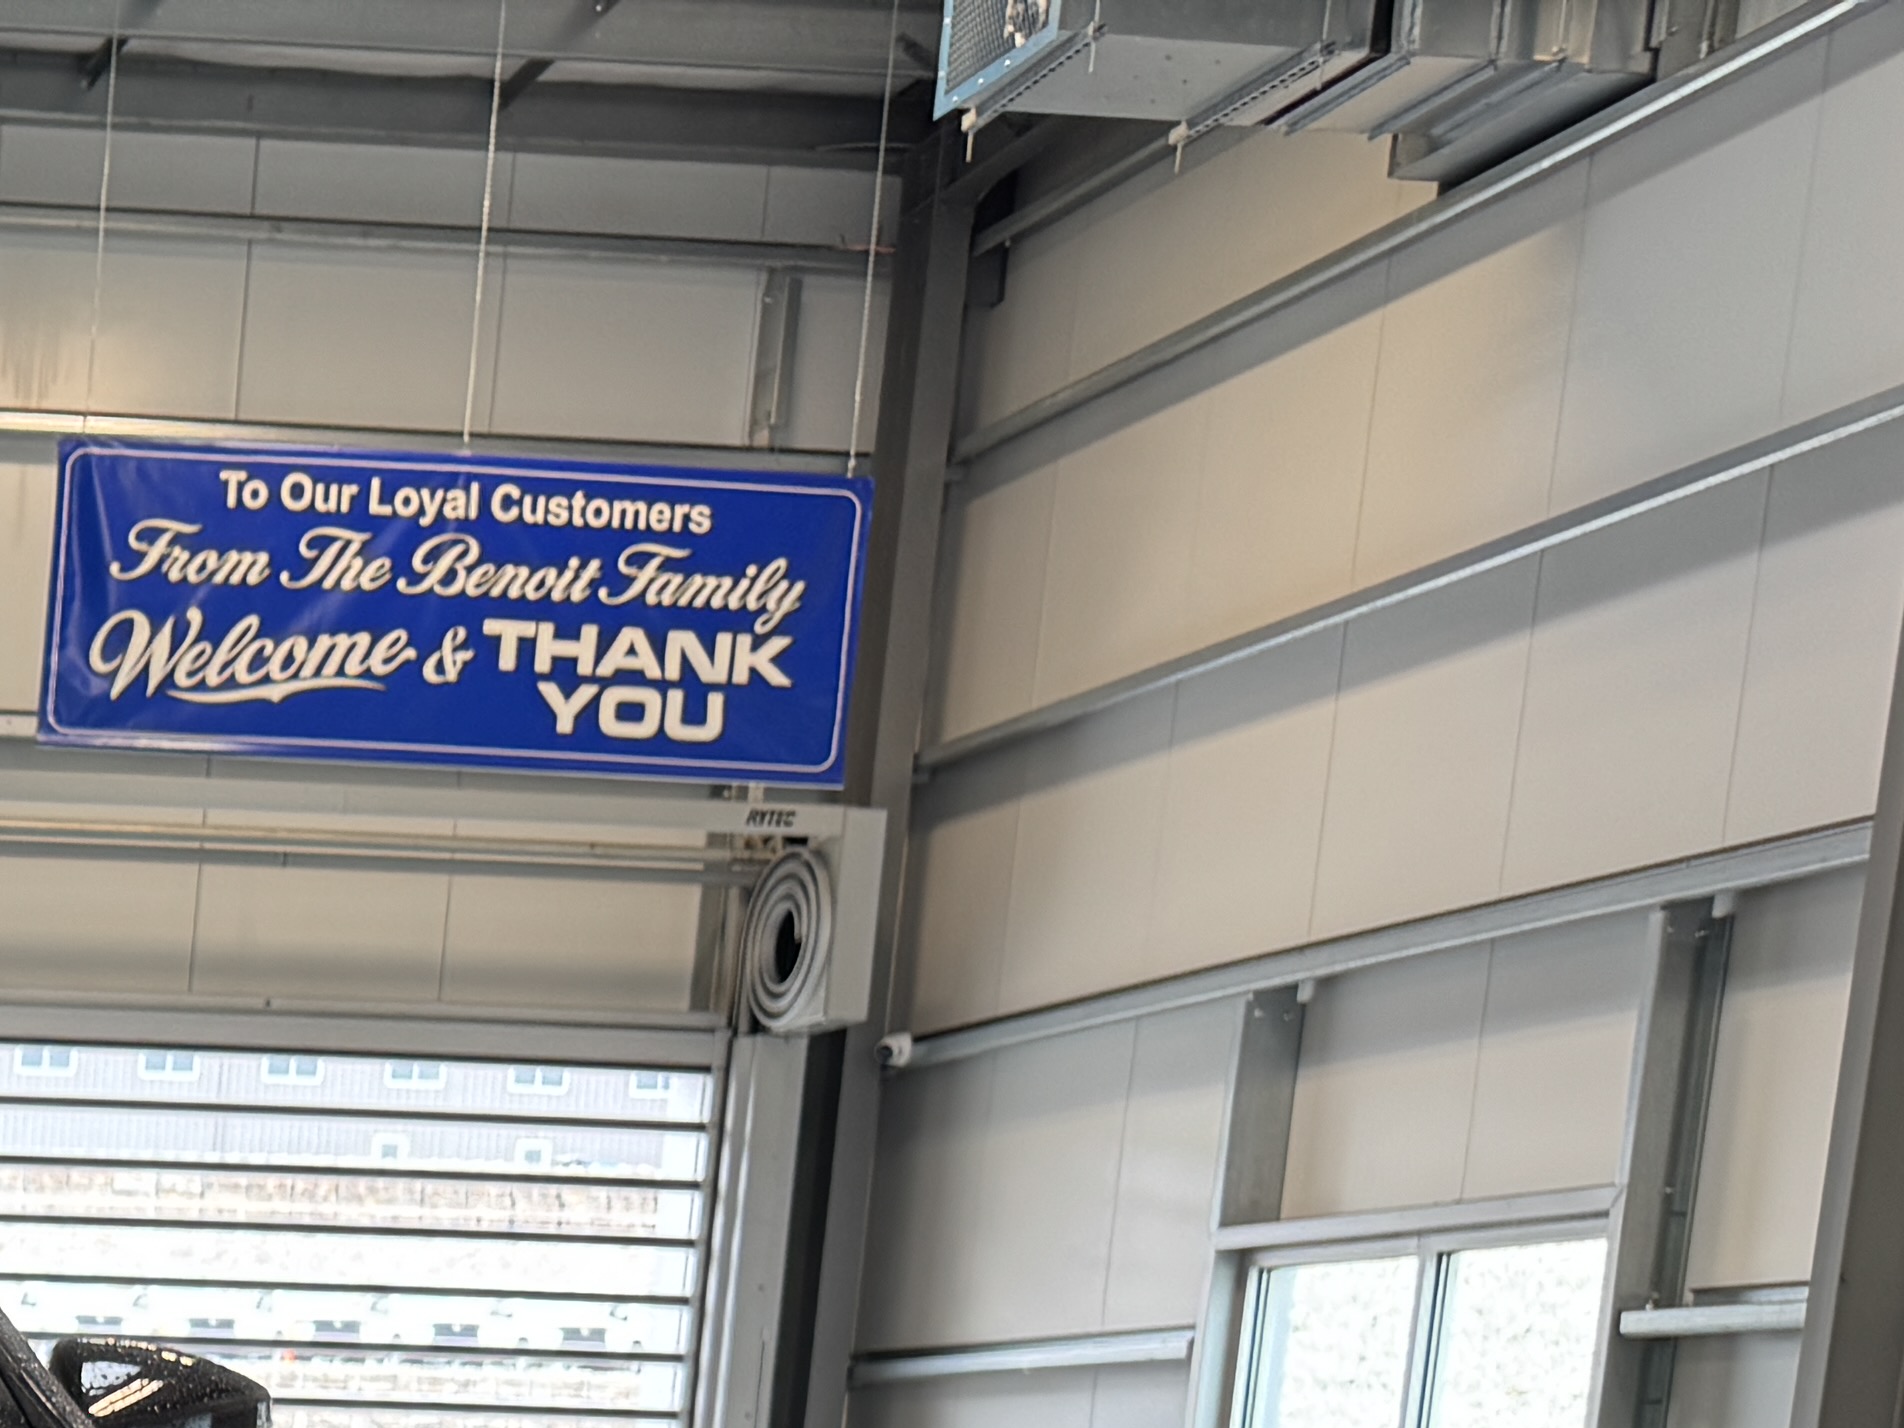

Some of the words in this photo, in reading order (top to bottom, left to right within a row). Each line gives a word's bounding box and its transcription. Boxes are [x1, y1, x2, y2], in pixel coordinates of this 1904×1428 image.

[219, 469, 270, 511] To
[280, 472, 361, 514] Our
[368, 475, 480, 528] Loyal
[490, 482, 713, 535] Customers
[109, 517, 273, 589] From
[278, 526, 393, 592] The
[396, 532, 601, 605] Benoit
[597, 541, 807, 635] Family
[88, 606, 417, 703] Welcome
[422, 625, 475, 685] &
[482, 616, 794, 688] THANK
[537, 682, 726, 743] YOU
